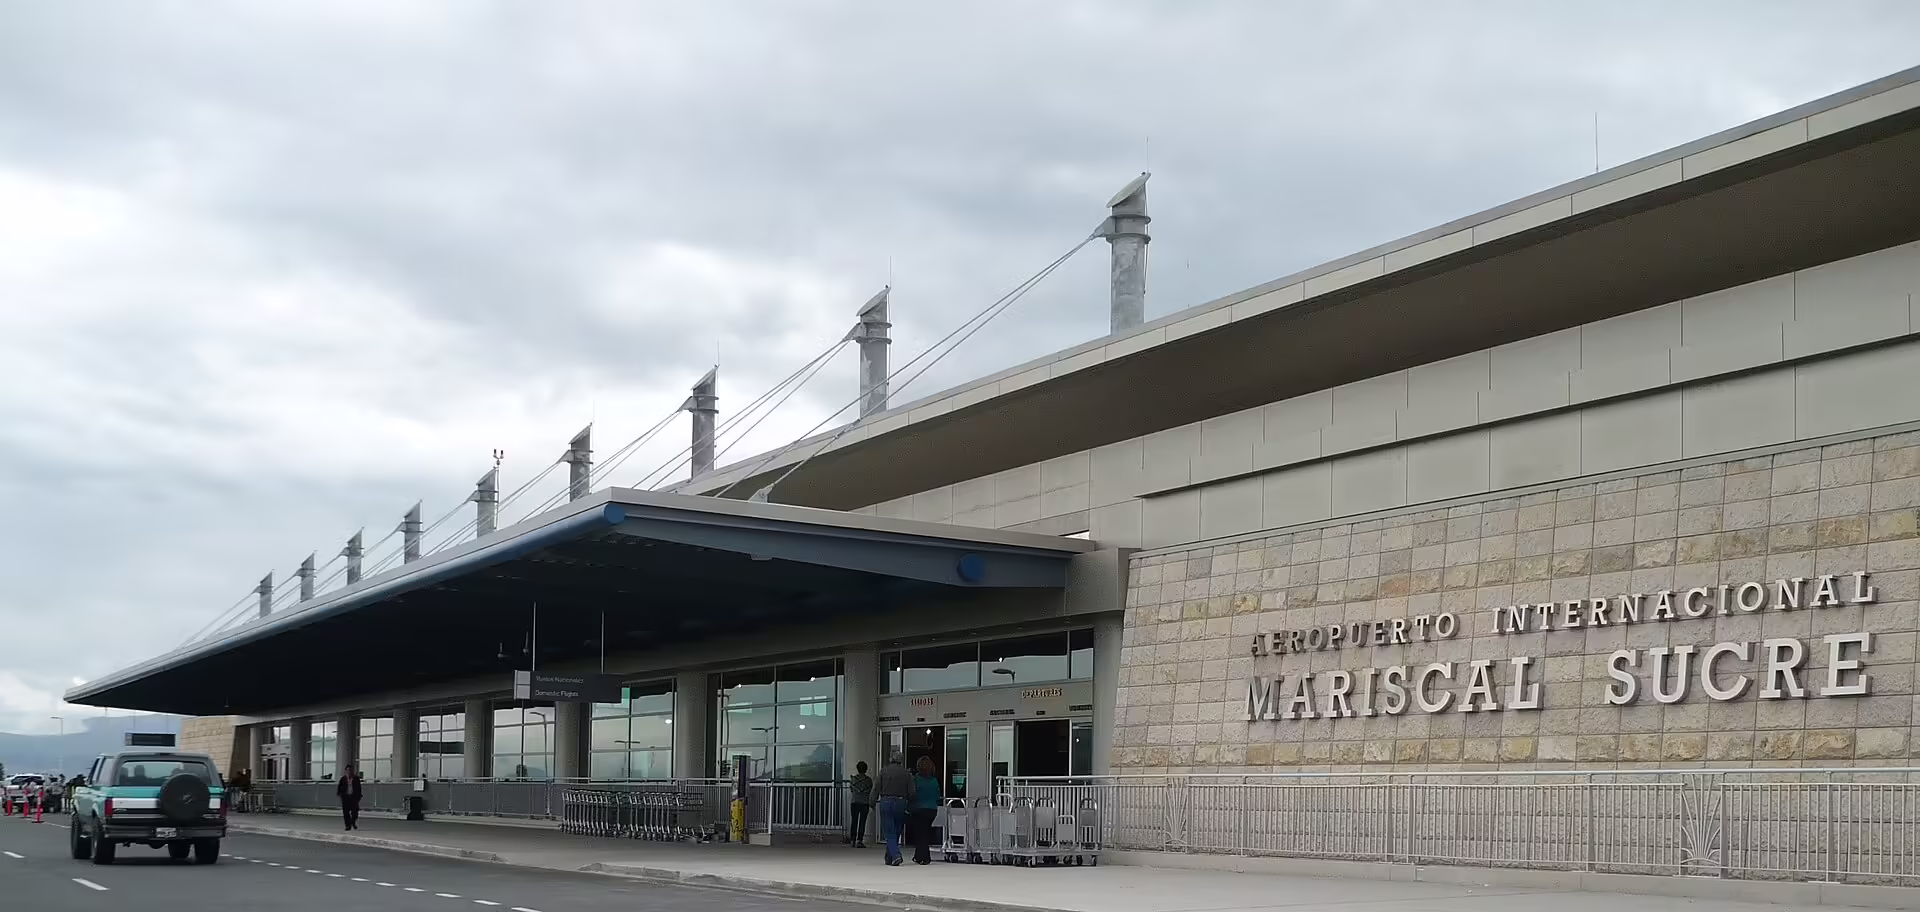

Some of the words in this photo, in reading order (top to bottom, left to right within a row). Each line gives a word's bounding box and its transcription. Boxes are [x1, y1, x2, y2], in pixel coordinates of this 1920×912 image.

[1250, 613, 1459, 656] AEROPUERTO
[1492, 570, 1879, 634] INTERNACIONAL
[560, 690, 579, 698] Flights
[1246, 656, 1543, 721] MARISCAL
[1604, 632, 1875, 706] SUCRE
